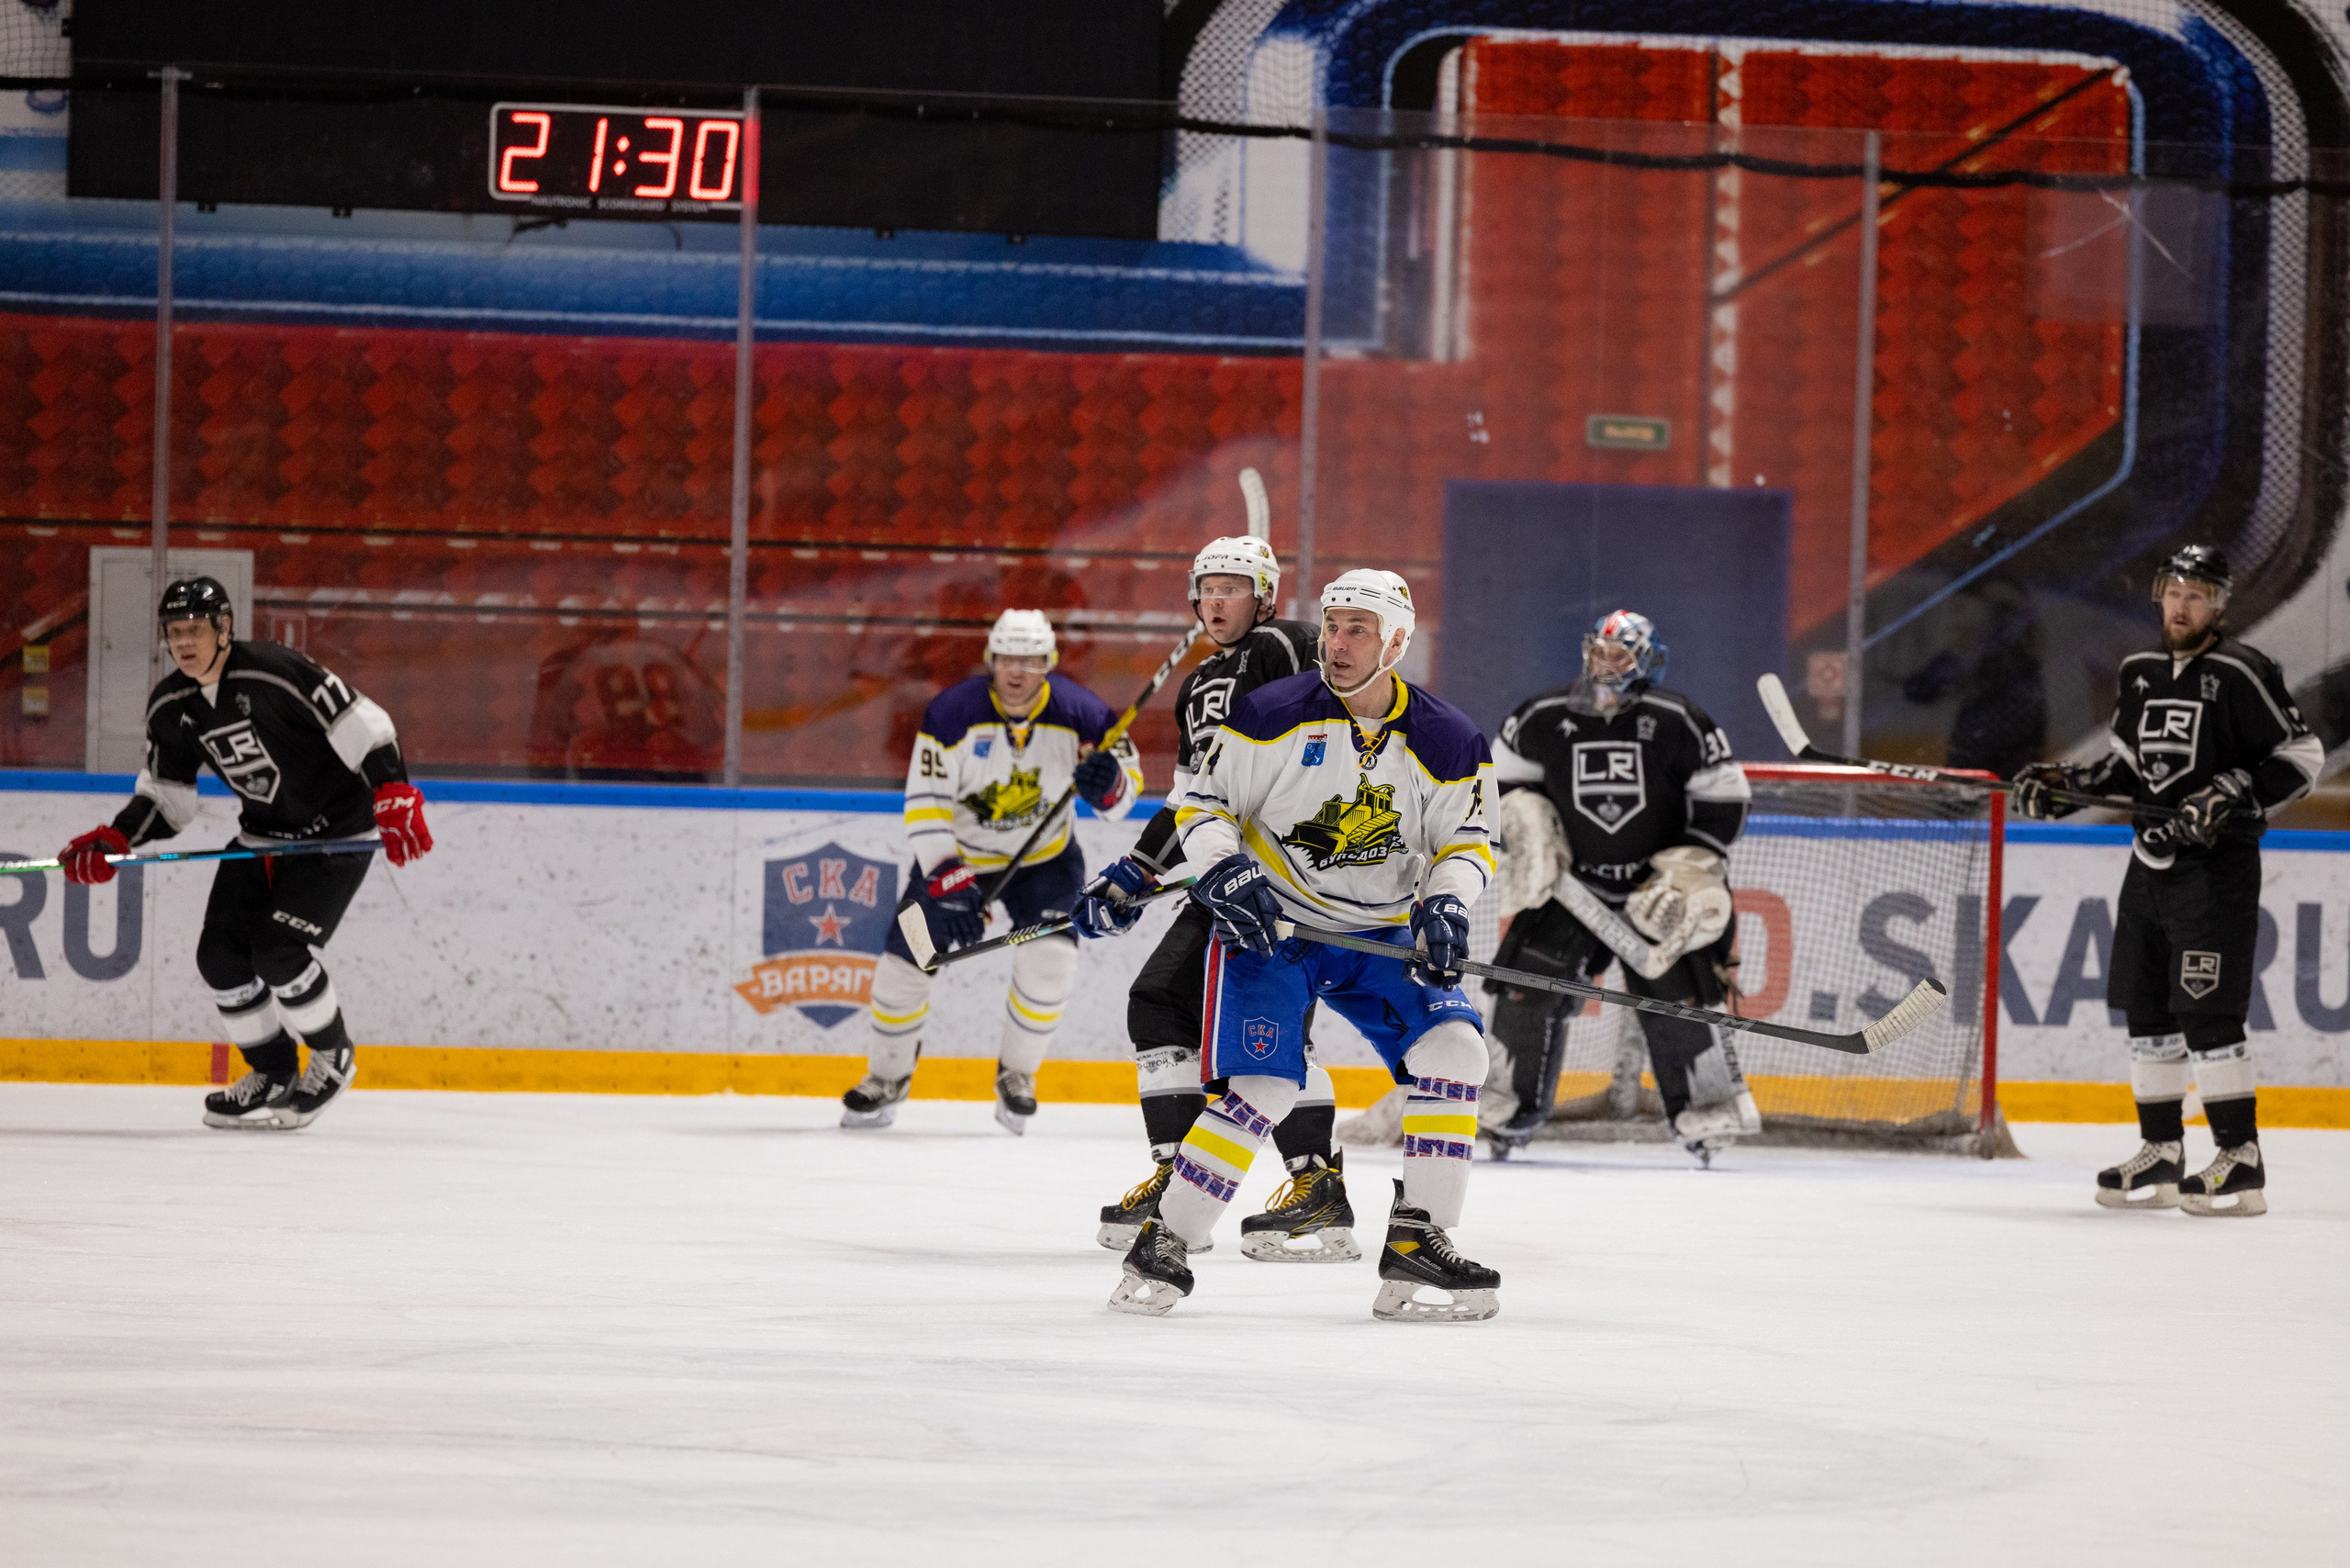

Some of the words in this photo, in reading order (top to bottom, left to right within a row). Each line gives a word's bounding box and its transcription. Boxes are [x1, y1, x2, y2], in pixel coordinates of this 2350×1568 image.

[499, 111, 740, 200] 21:30
[311, 672, 351, 717] 77
[2140, 710, 2193, 740] LR
[209, 728, 261, 766] LR
[1579, 751, 1637, 781] LR
[1867, 759, 1939, 782] CCM
[373, 796, 416, 815] CM
[782, 857, 880, 909] СКА
[1224, 865, 1264, 897] BAU
[273, 909, 322, 936] CCM
[2185, 956, 2215, 973] LR
[759, 965, 872, 999] ВАРЯГ
[1637, 999, 1757, 1032] CCM
[1248, 1024, 1275, 1039] СКА
